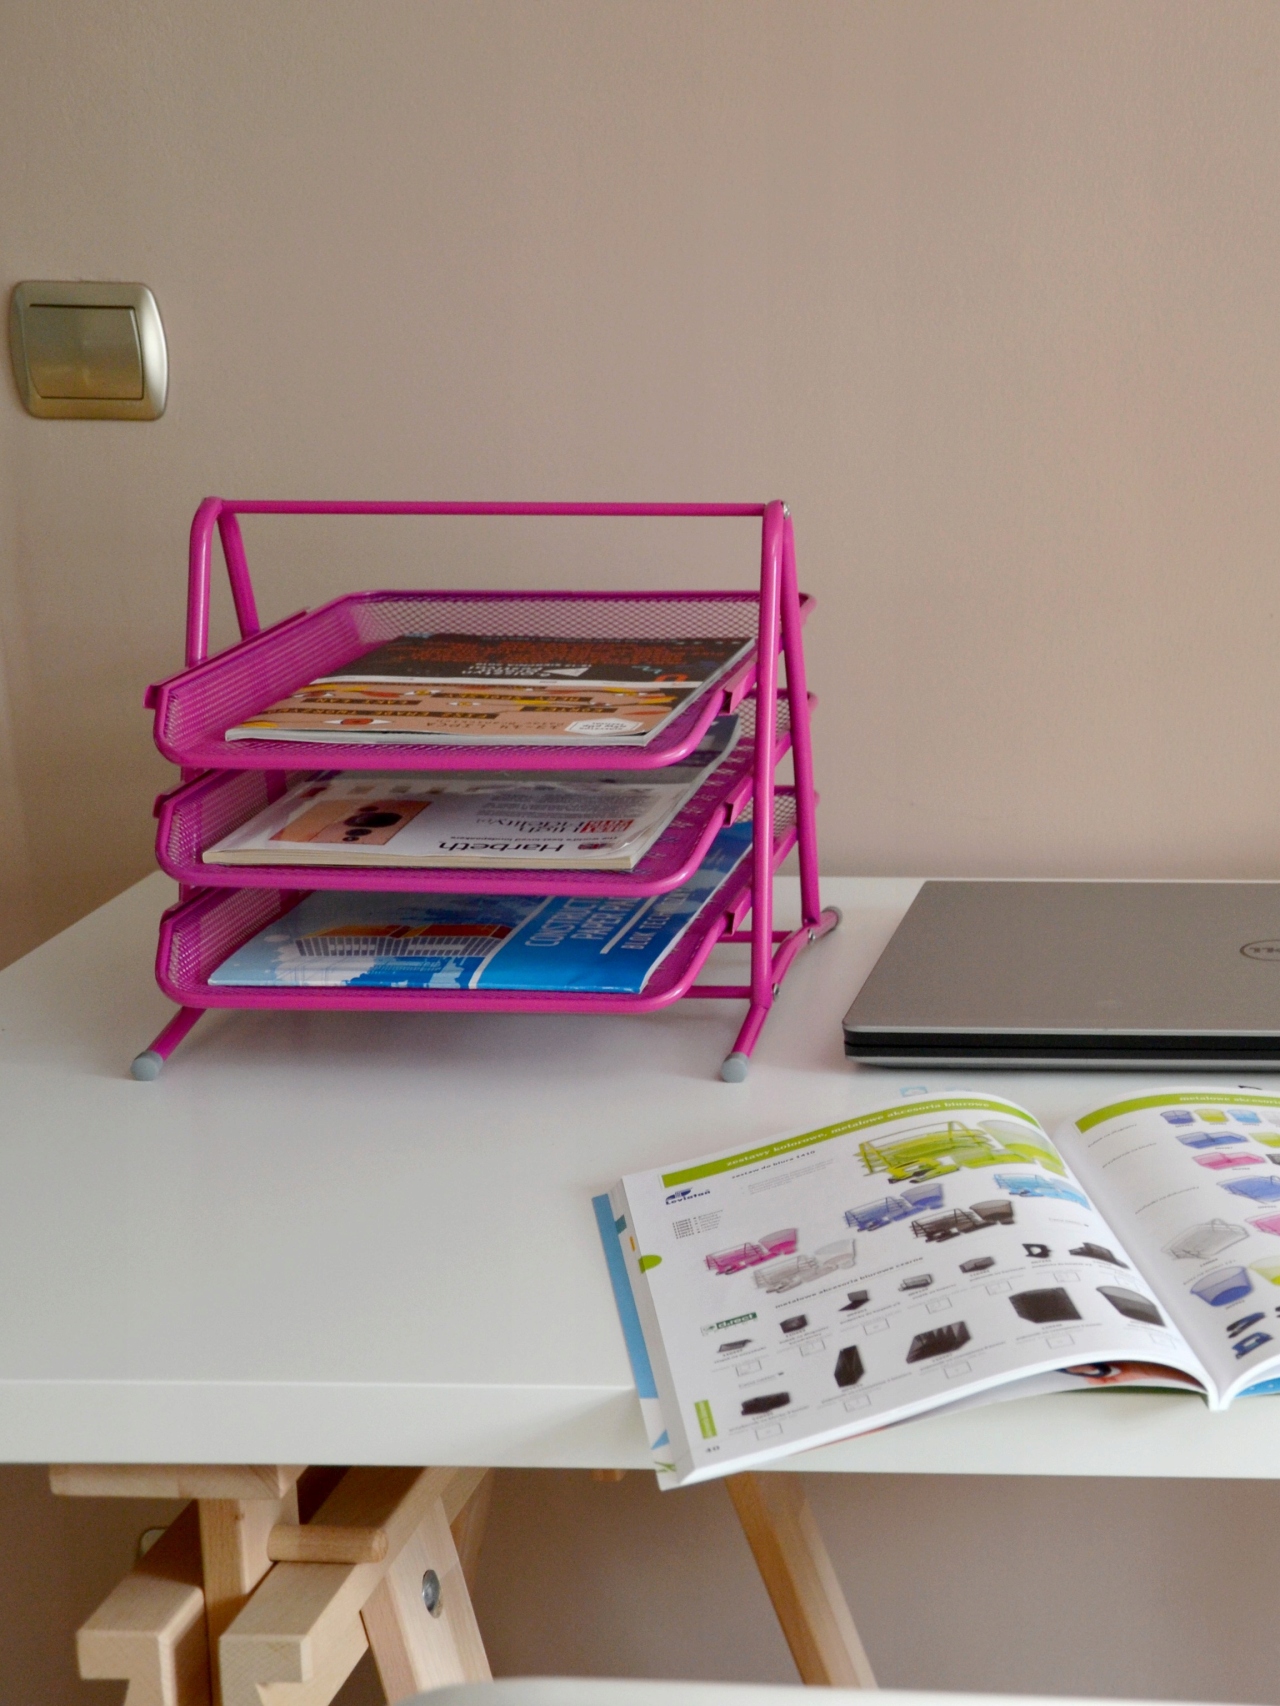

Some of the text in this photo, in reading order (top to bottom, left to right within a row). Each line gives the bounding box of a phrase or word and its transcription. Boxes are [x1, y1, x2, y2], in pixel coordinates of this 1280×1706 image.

[439, 841, 564, 852] Harbeth
[570, 911, 628, 940] PAPER
[620, 931, 658, 950] BLOK
[726, 1149, 771, 1167] zestawy
[831, 1114, 885, 1134] metalowe
[887, 1102, 941, 1118] akcesoria
[944, 1100, 990, 1108] biurowe
[731, 1168, 760, 1179] zestaw
[773, 1157, 795, 1167] biura
[665, 1189, 711, 1205] Leviatan
[774, 1256, 924, 1309] metalowe akcesoria biurowe czarne
